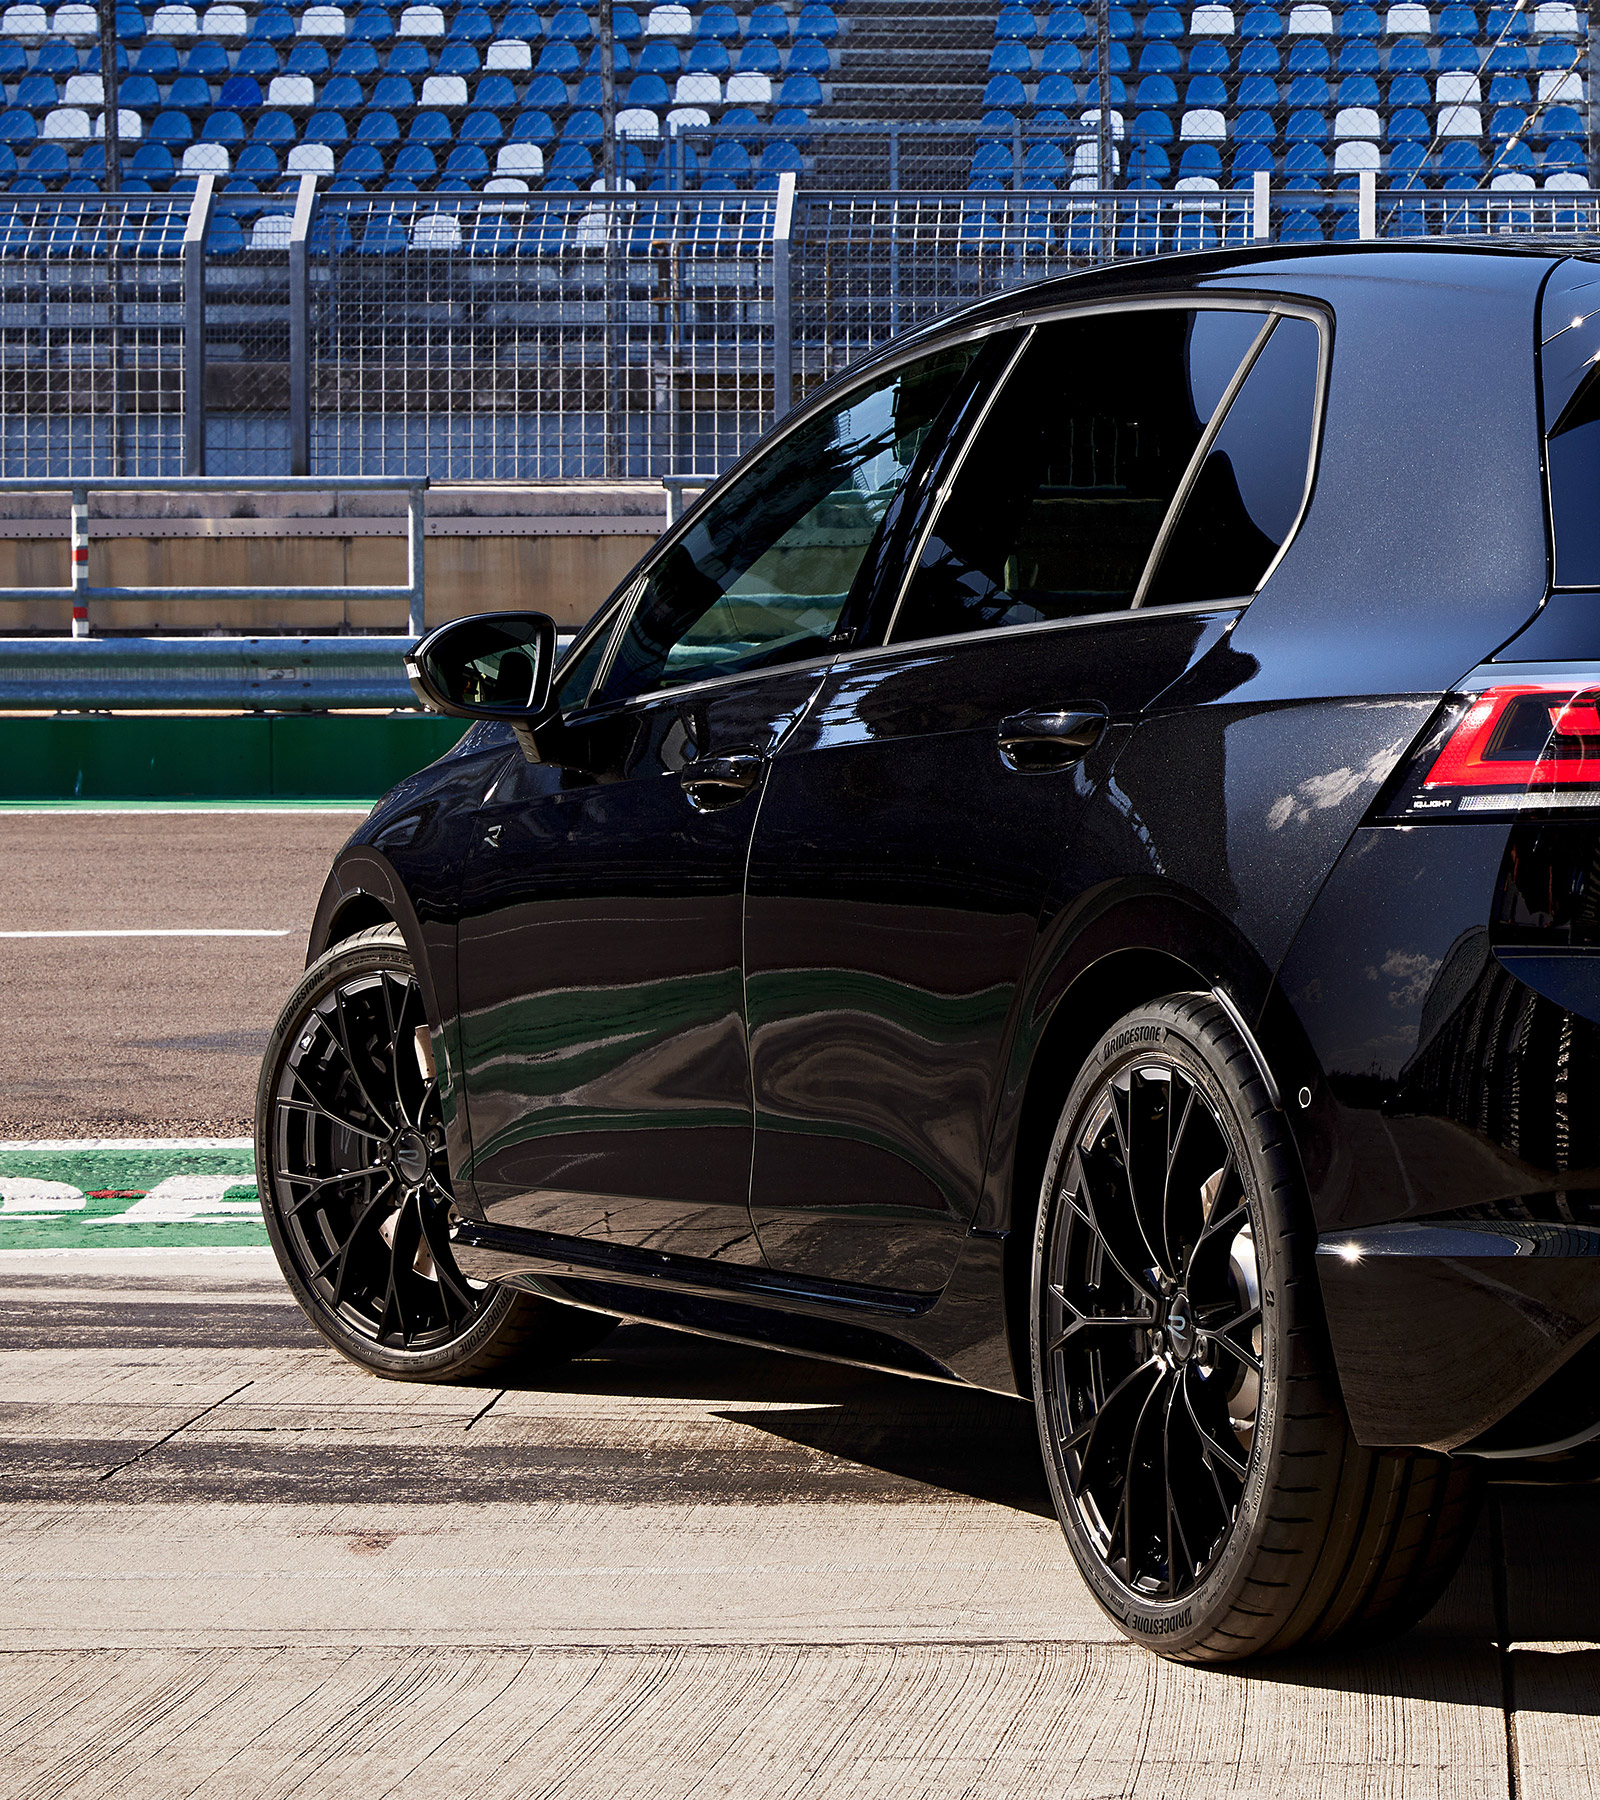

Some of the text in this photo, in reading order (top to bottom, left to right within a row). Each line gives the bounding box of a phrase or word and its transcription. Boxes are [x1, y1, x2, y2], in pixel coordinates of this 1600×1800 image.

[276, 969, 326, 1040] BRIDGESTONE
[1103, 1025, 1162, 1062] BRIDGESTONE
[458, 1286, 512, 1356] BRIDGESTONE
[1131, 1605, 1193, 1636] BRIDGESTONE
